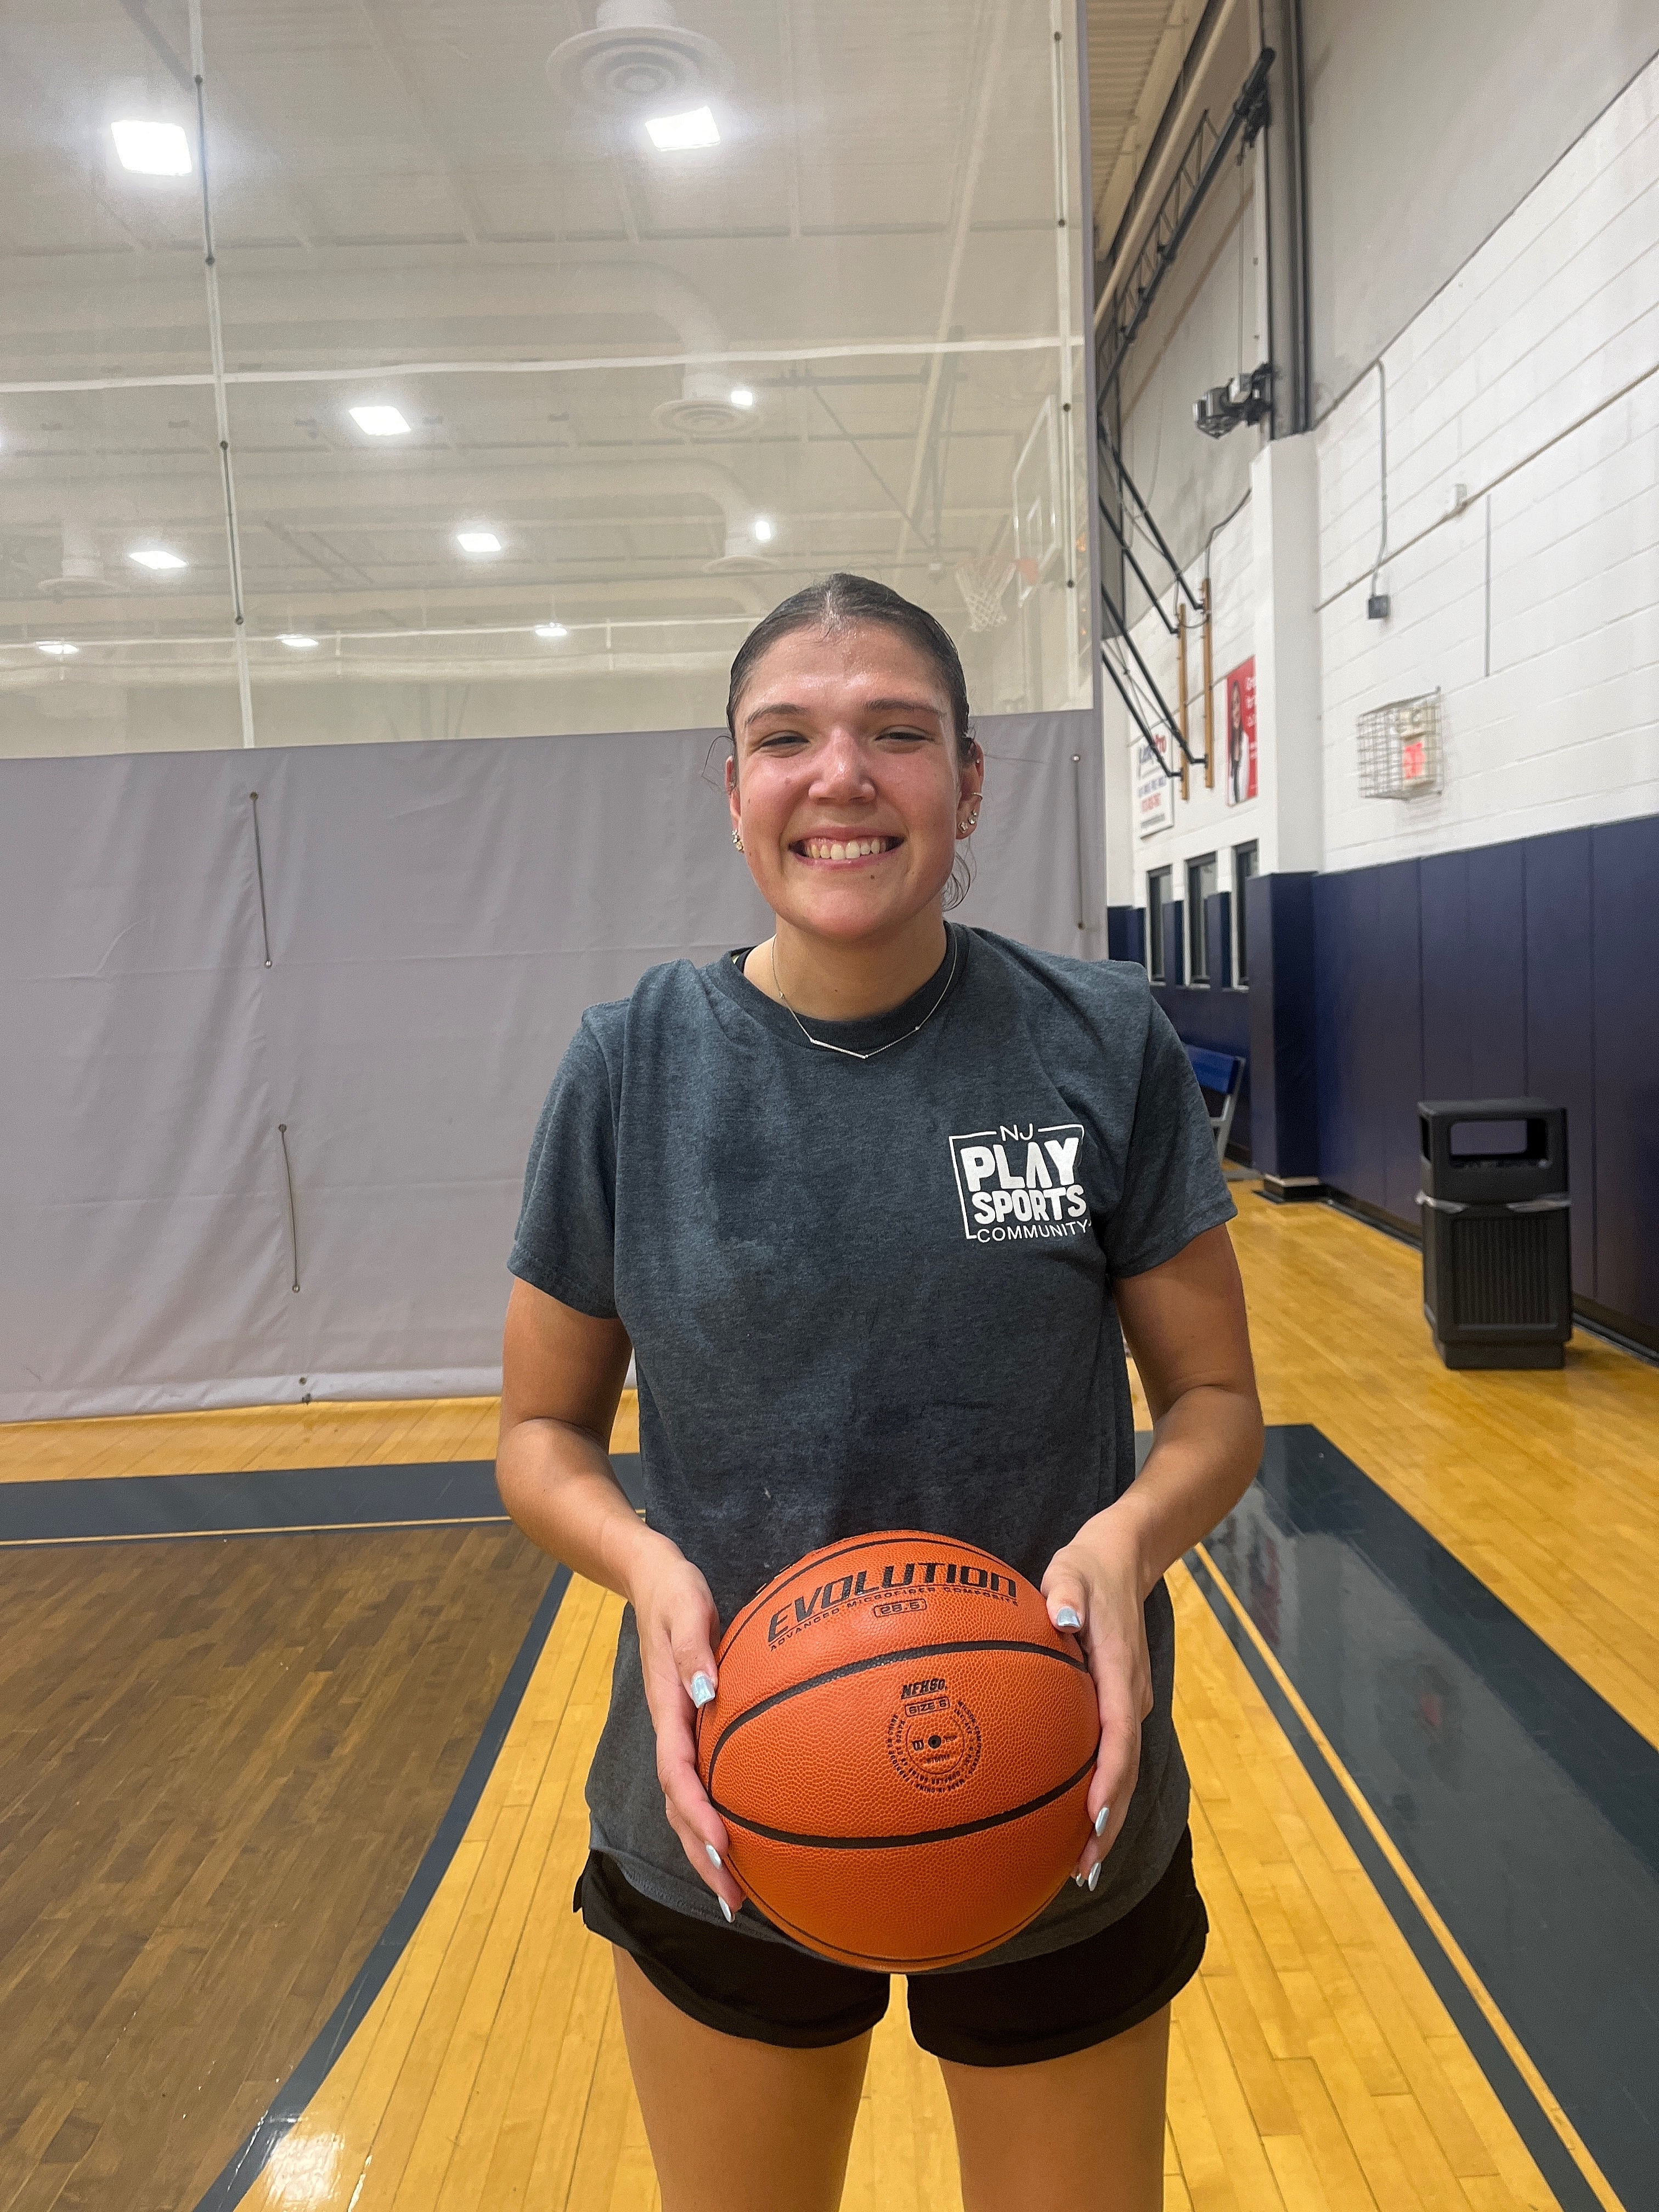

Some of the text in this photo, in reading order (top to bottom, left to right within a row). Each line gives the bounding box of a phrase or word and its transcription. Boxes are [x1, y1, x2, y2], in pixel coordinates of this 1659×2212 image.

[1000, 1123, 1033, 1141] NJ
[960, 1137, 1080, 1192] PLAY
[972, 1184, 1087, 1224] SPORTS
[977, 1219, 1088, 1243] COMMUNITY
[768, 1562, 1017, 1643] EVOLUTION
[770, 1587, 1019, 1652] ADVANCED MICROFIBER COMPOSITE
[909, 1699, 947, 1714] SIZE 6
